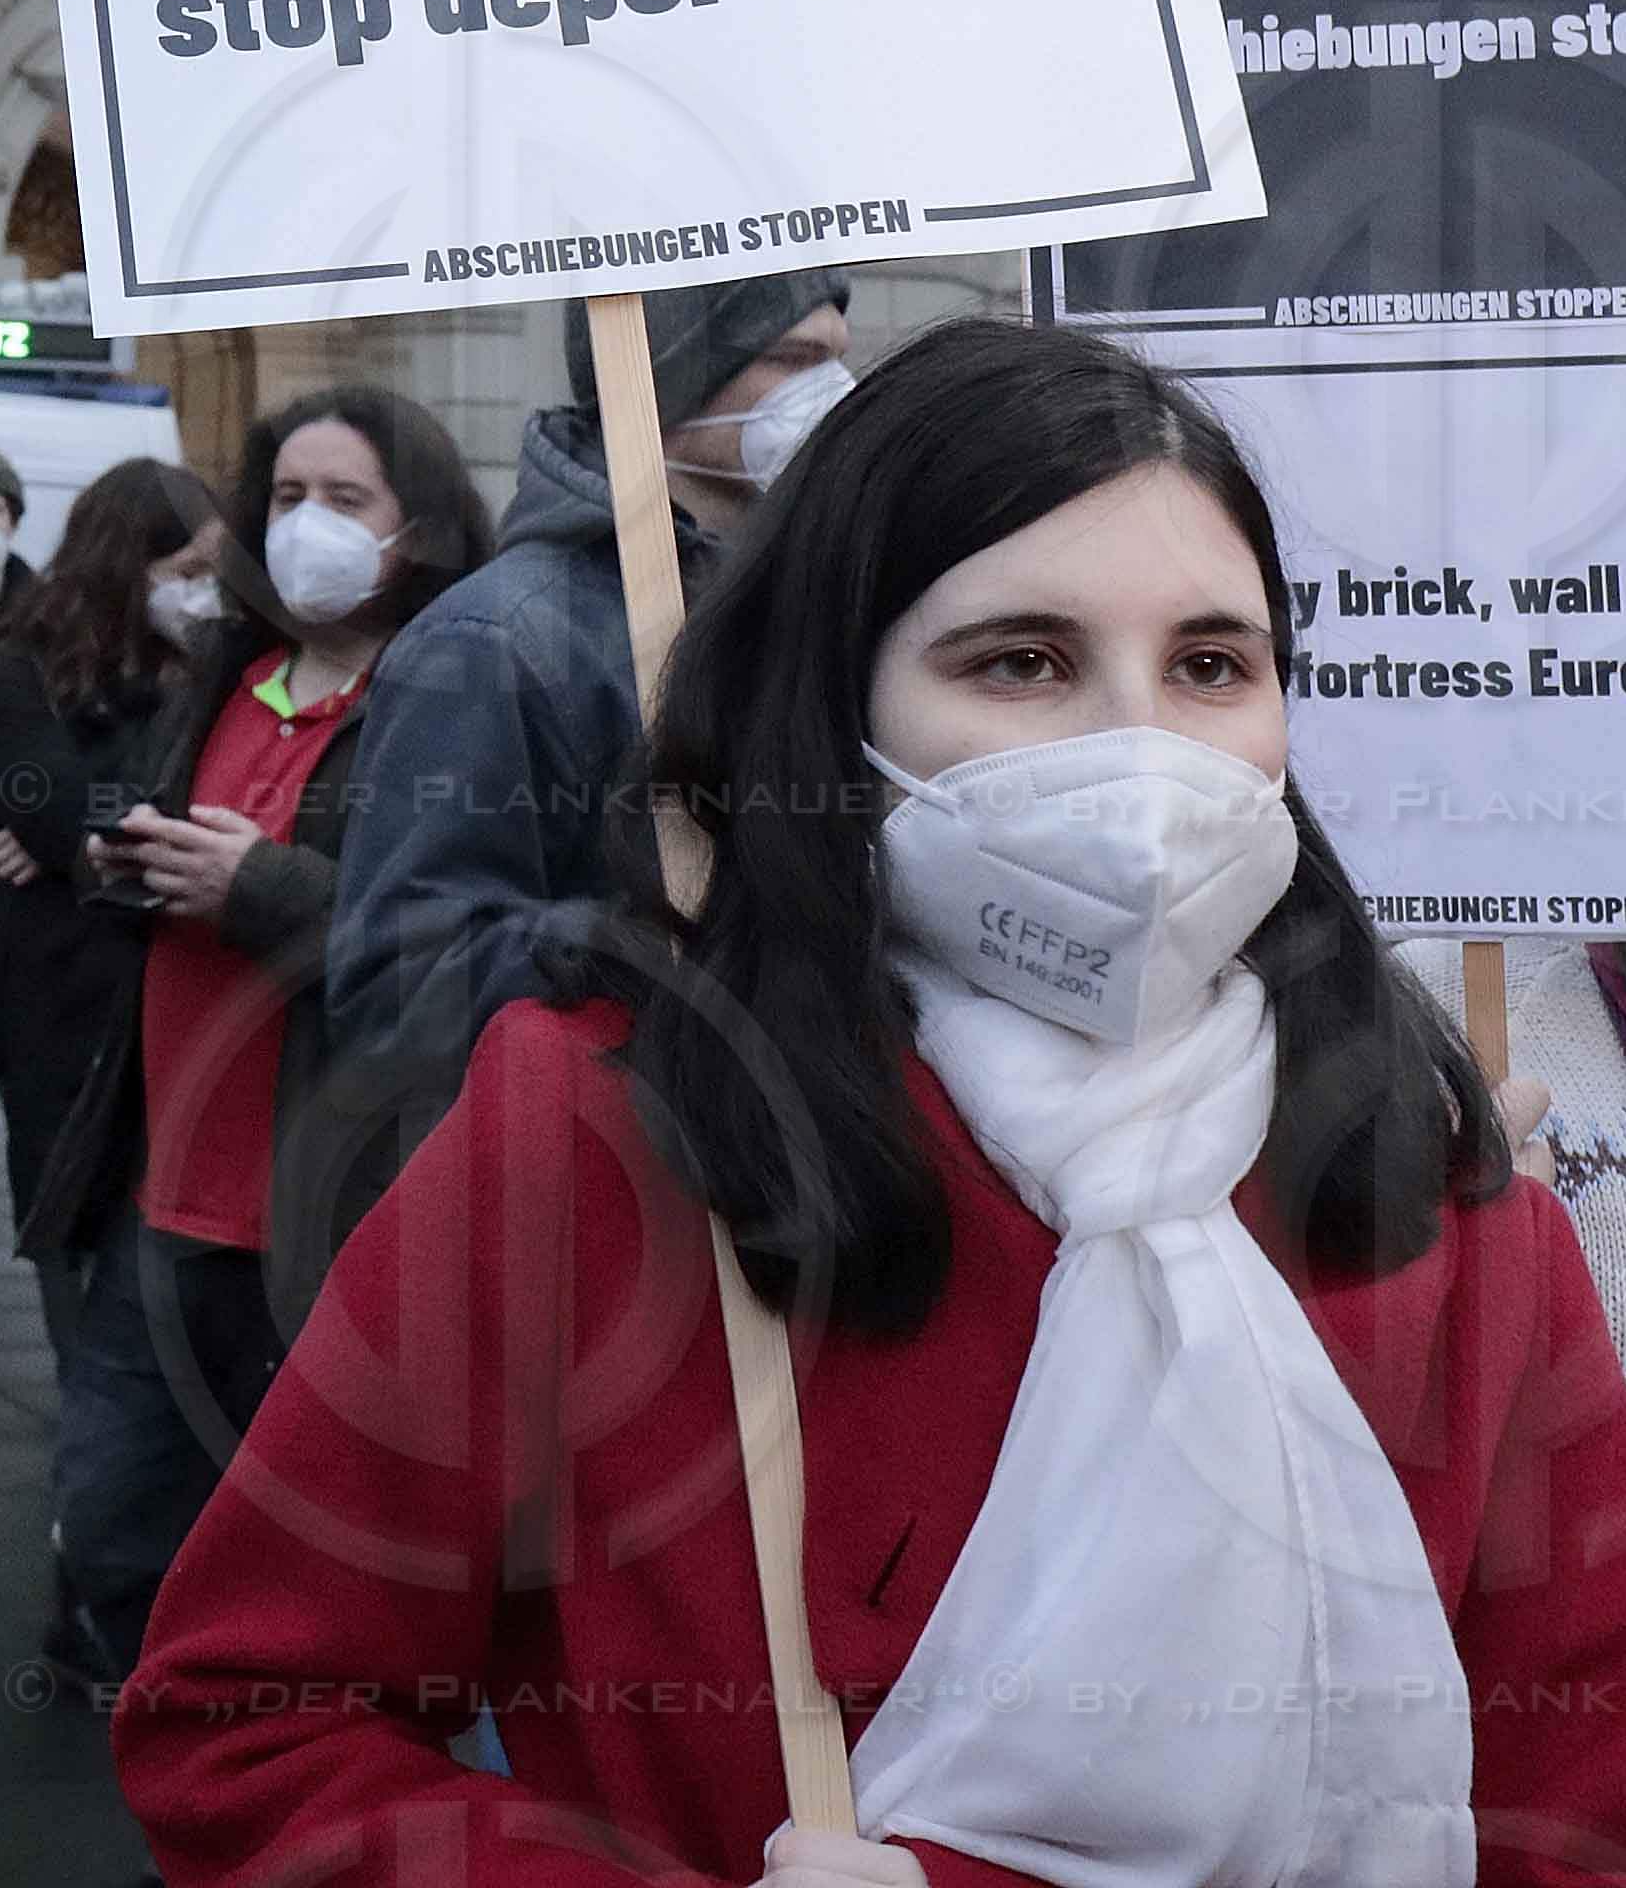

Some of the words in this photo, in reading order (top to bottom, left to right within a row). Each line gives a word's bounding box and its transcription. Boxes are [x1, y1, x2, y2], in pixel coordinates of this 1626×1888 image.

[424, 222, 729, 282] ABSCHIEBUNGEN
[738, 200, 911, 250] STOPPEN
[1275, 291, 1509, 325] ABSCHIEBUNGEN
[1338, 566, 1492, 622] brick,
[1509, 565, 1620, 613] wall
[1019, 917, 1112, 979] FFP2
